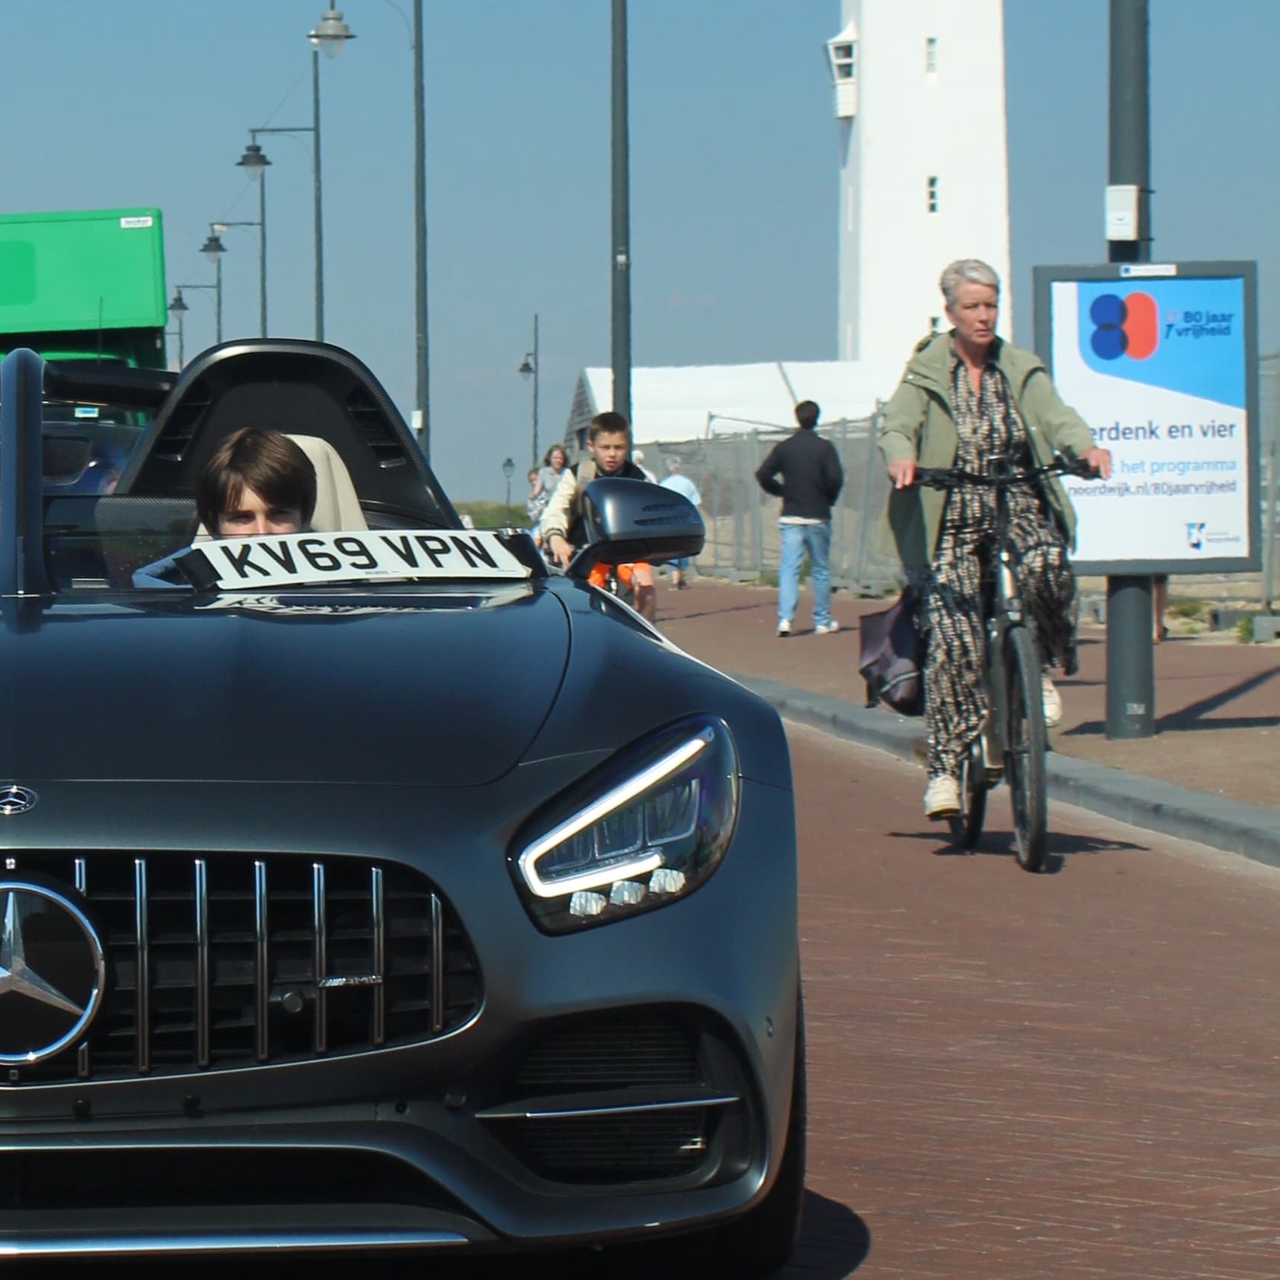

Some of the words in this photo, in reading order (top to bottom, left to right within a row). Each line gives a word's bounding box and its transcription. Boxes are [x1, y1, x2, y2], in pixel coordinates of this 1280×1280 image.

[1183, 310, 1202, 324] 80
[1205, 310, 1234, 326] jaar
[1175, 323, 1231, 339] vrijheid
[1089, 421, 1160, 441] erdenk
[1167, 424, 1193, 439] en
[1200, 420, 1236, 438] vier
[1120, 460, 1146, 474] het
[1151, 459, 1237, 476] programma
[219, 537, 378, 578] KV69
[379, 535, 498, 569] VPN
